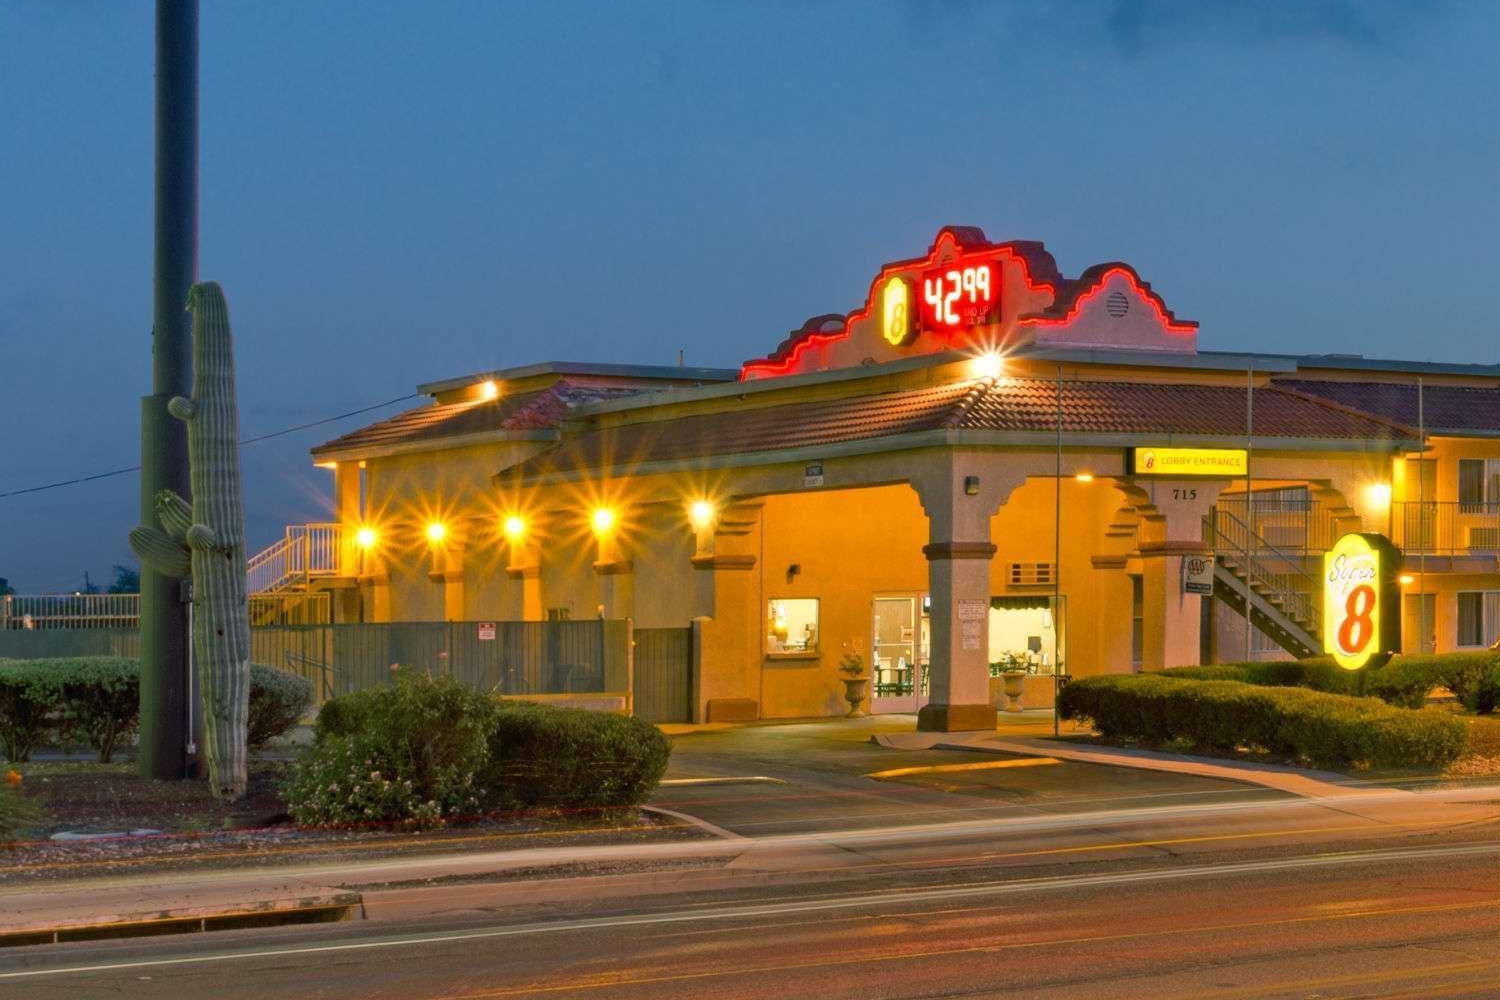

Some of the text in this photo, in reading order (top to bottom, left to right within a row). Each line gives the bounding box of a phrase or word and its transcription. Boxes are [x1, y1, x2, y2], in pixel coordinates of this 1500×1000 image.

[1160, 455, 1191, 465] LOBBY
[1193, 456, 1241, 467] ENTRANCE
[1172, 488, 1197, 500] 715
[1328, 553, 1377, 594] Super
[1337, 584, 1376, 656] 8
